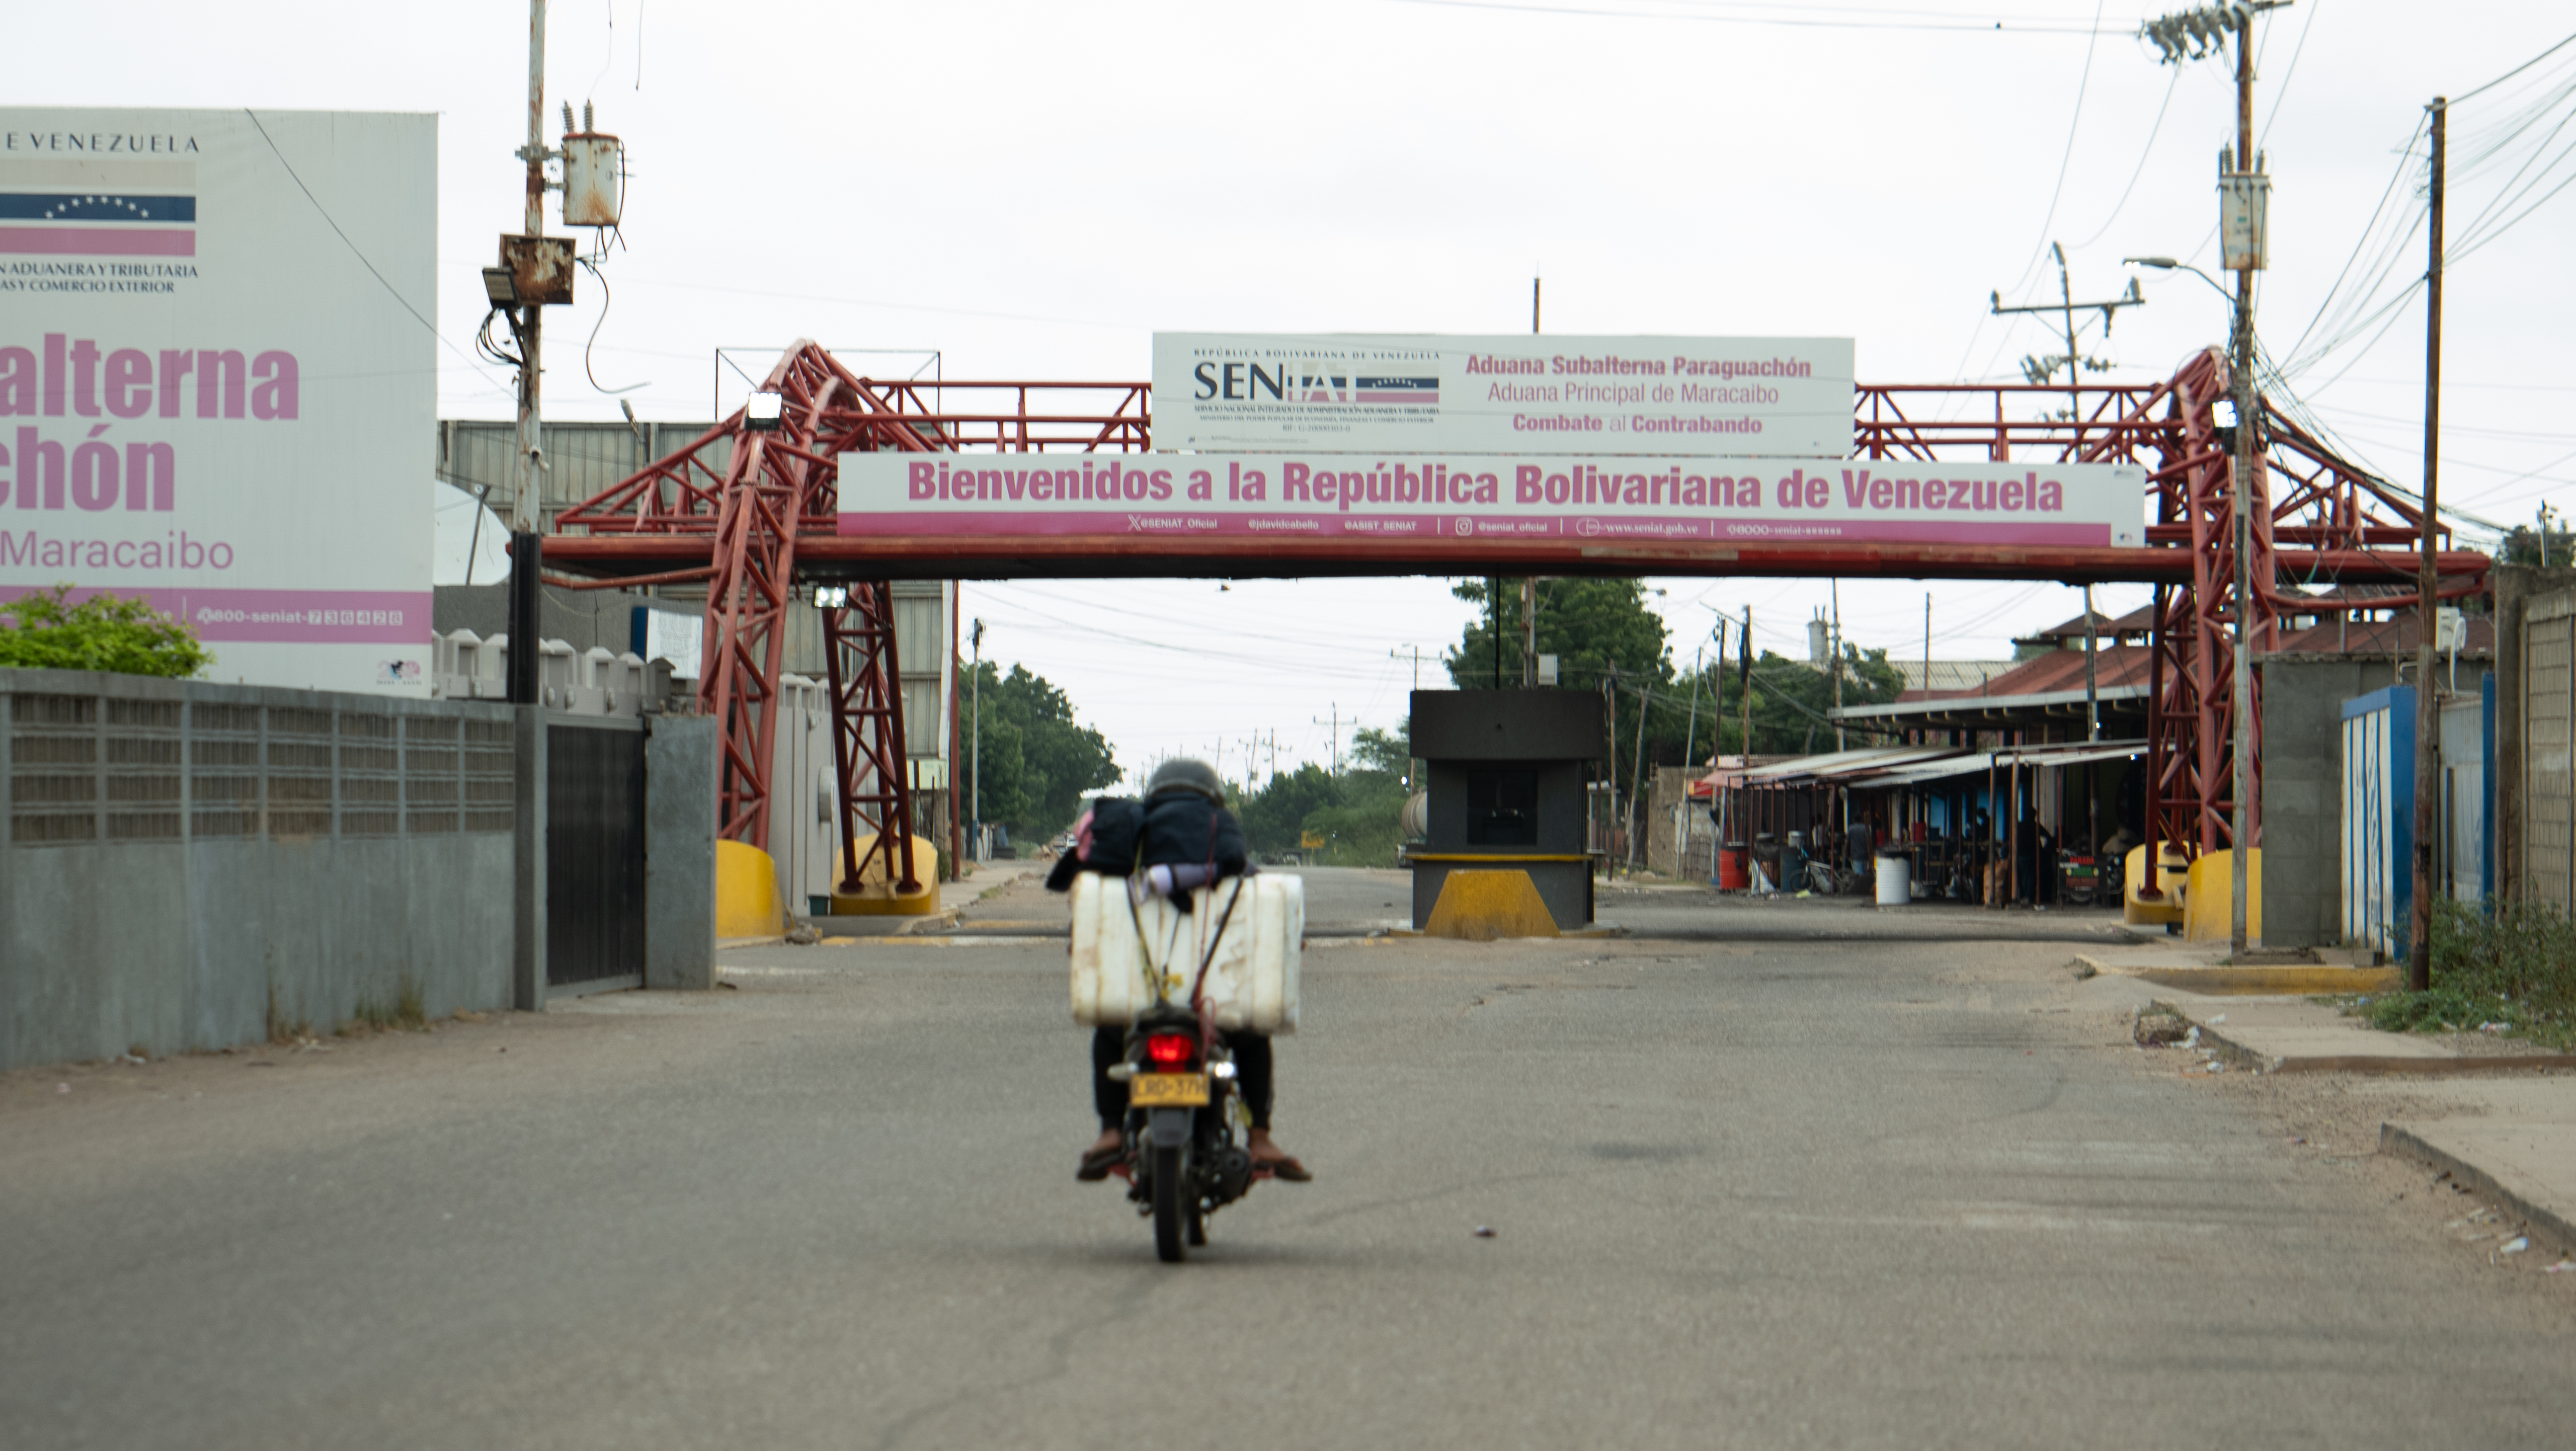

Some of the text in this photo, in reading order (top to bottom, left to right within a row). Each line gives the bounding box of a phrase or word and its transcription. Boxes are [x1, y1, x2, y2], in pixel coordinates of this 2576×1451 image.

[30, 132, 199, 153] VENEZUELA
[9, 261, 95, 276] ADUANERA
[98, 263, 106, 276] Y
[110, 263, 199, 279] TRIBUTARIA
[18, 279, 27, 292] Y
[29, 278, 105, 293] COMERCIO
[109, 280, 175, 294] EXTERIOR
[1194, 346, 1441, 361] REPÚBLICA BOLIVARIANA DE VENEZUELA
[0, 332, 299, 420] alterna
[1466, 354, 1811, 380] Aduana Subalterna Paraguachón
[1194, 362, 1367, 402] SENIAT
[1488, 381, 1779, 406] Aduana Principal de Maracaibo
[1513, 413, 1763, 434] Combate al Contrabando
[0, 423, 174, 511] hón
[908, 460, 2064, 512] Bienvenidos a la República Bolivariana de Venezuela
[0, 529, 234, 570] Maracaibo
